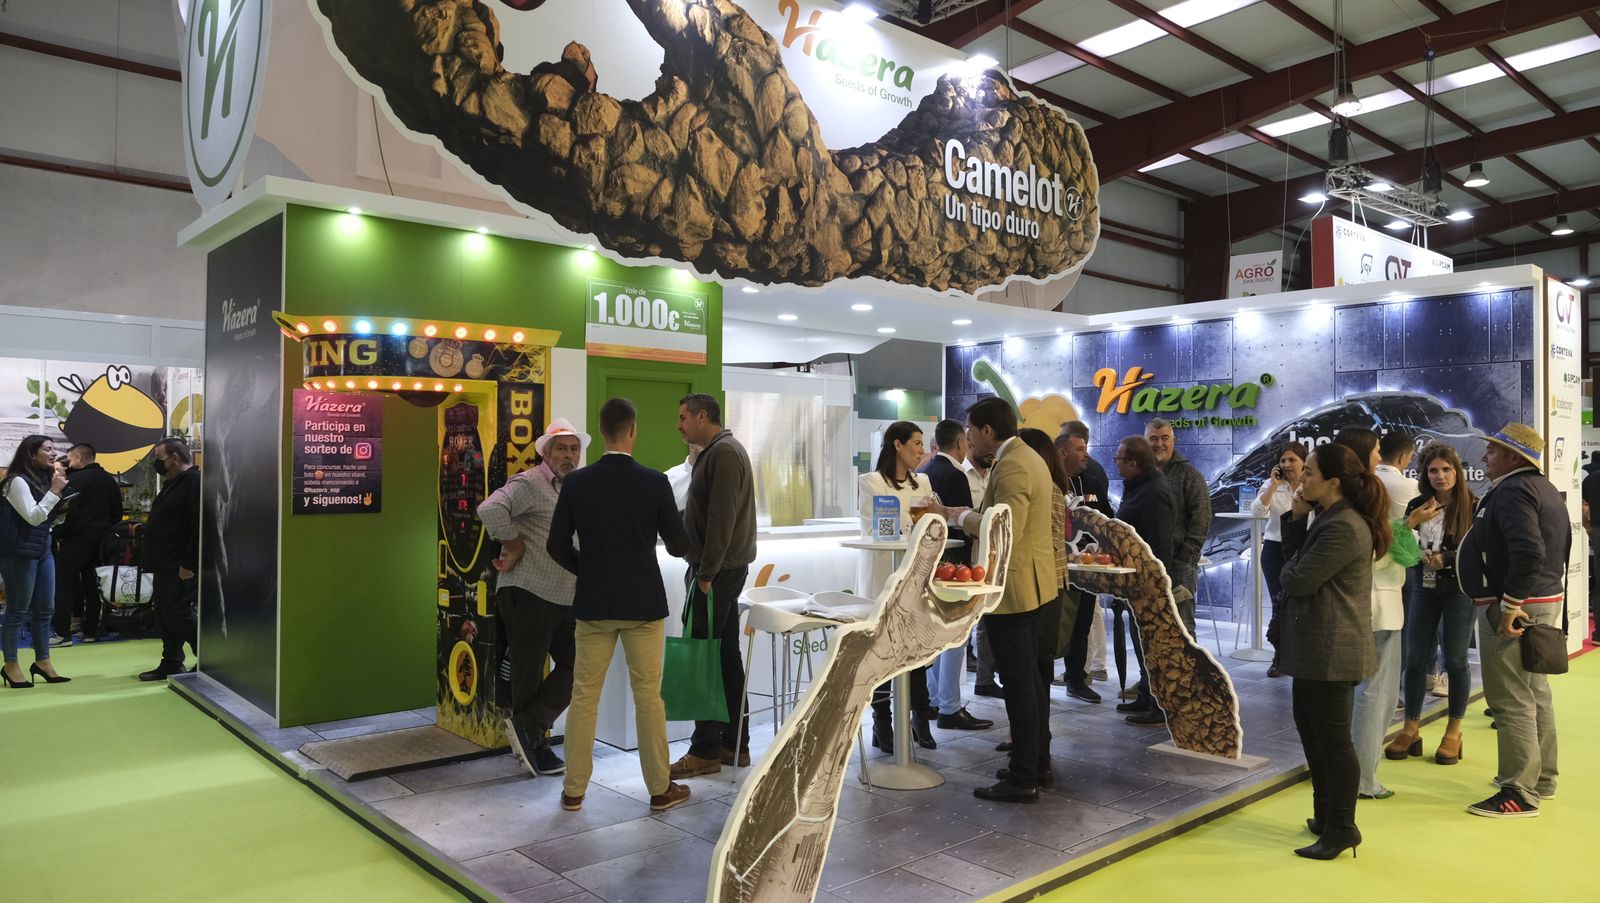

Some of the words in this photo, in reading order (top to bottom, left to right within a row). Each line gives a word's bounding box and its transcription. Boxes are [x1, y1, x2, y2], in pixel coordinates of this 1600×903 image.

[778, 0, 915, 92] Haera
[868, 87, 878, 97] of
[880, 88, 913, 108] Growth
[945, 138, 1063, 217] Camelot
[945, 193, 967, 222] Un
[971, 201, 1001, 233] tipo
[1006, 210, 1040, 240] duro
[1235, 266, 1274, 280] AGRO
[593, 291, 680, 331] 1.000€
[305, 420, 351, 433] Participa
[304, 433, 344, 442] nuestro
[304, 444, 337, 454] sorteo
[340, 444, 353, 454] de
[303, 496, 310, 507] y
[312, 494, 362, 507] síguenos!
